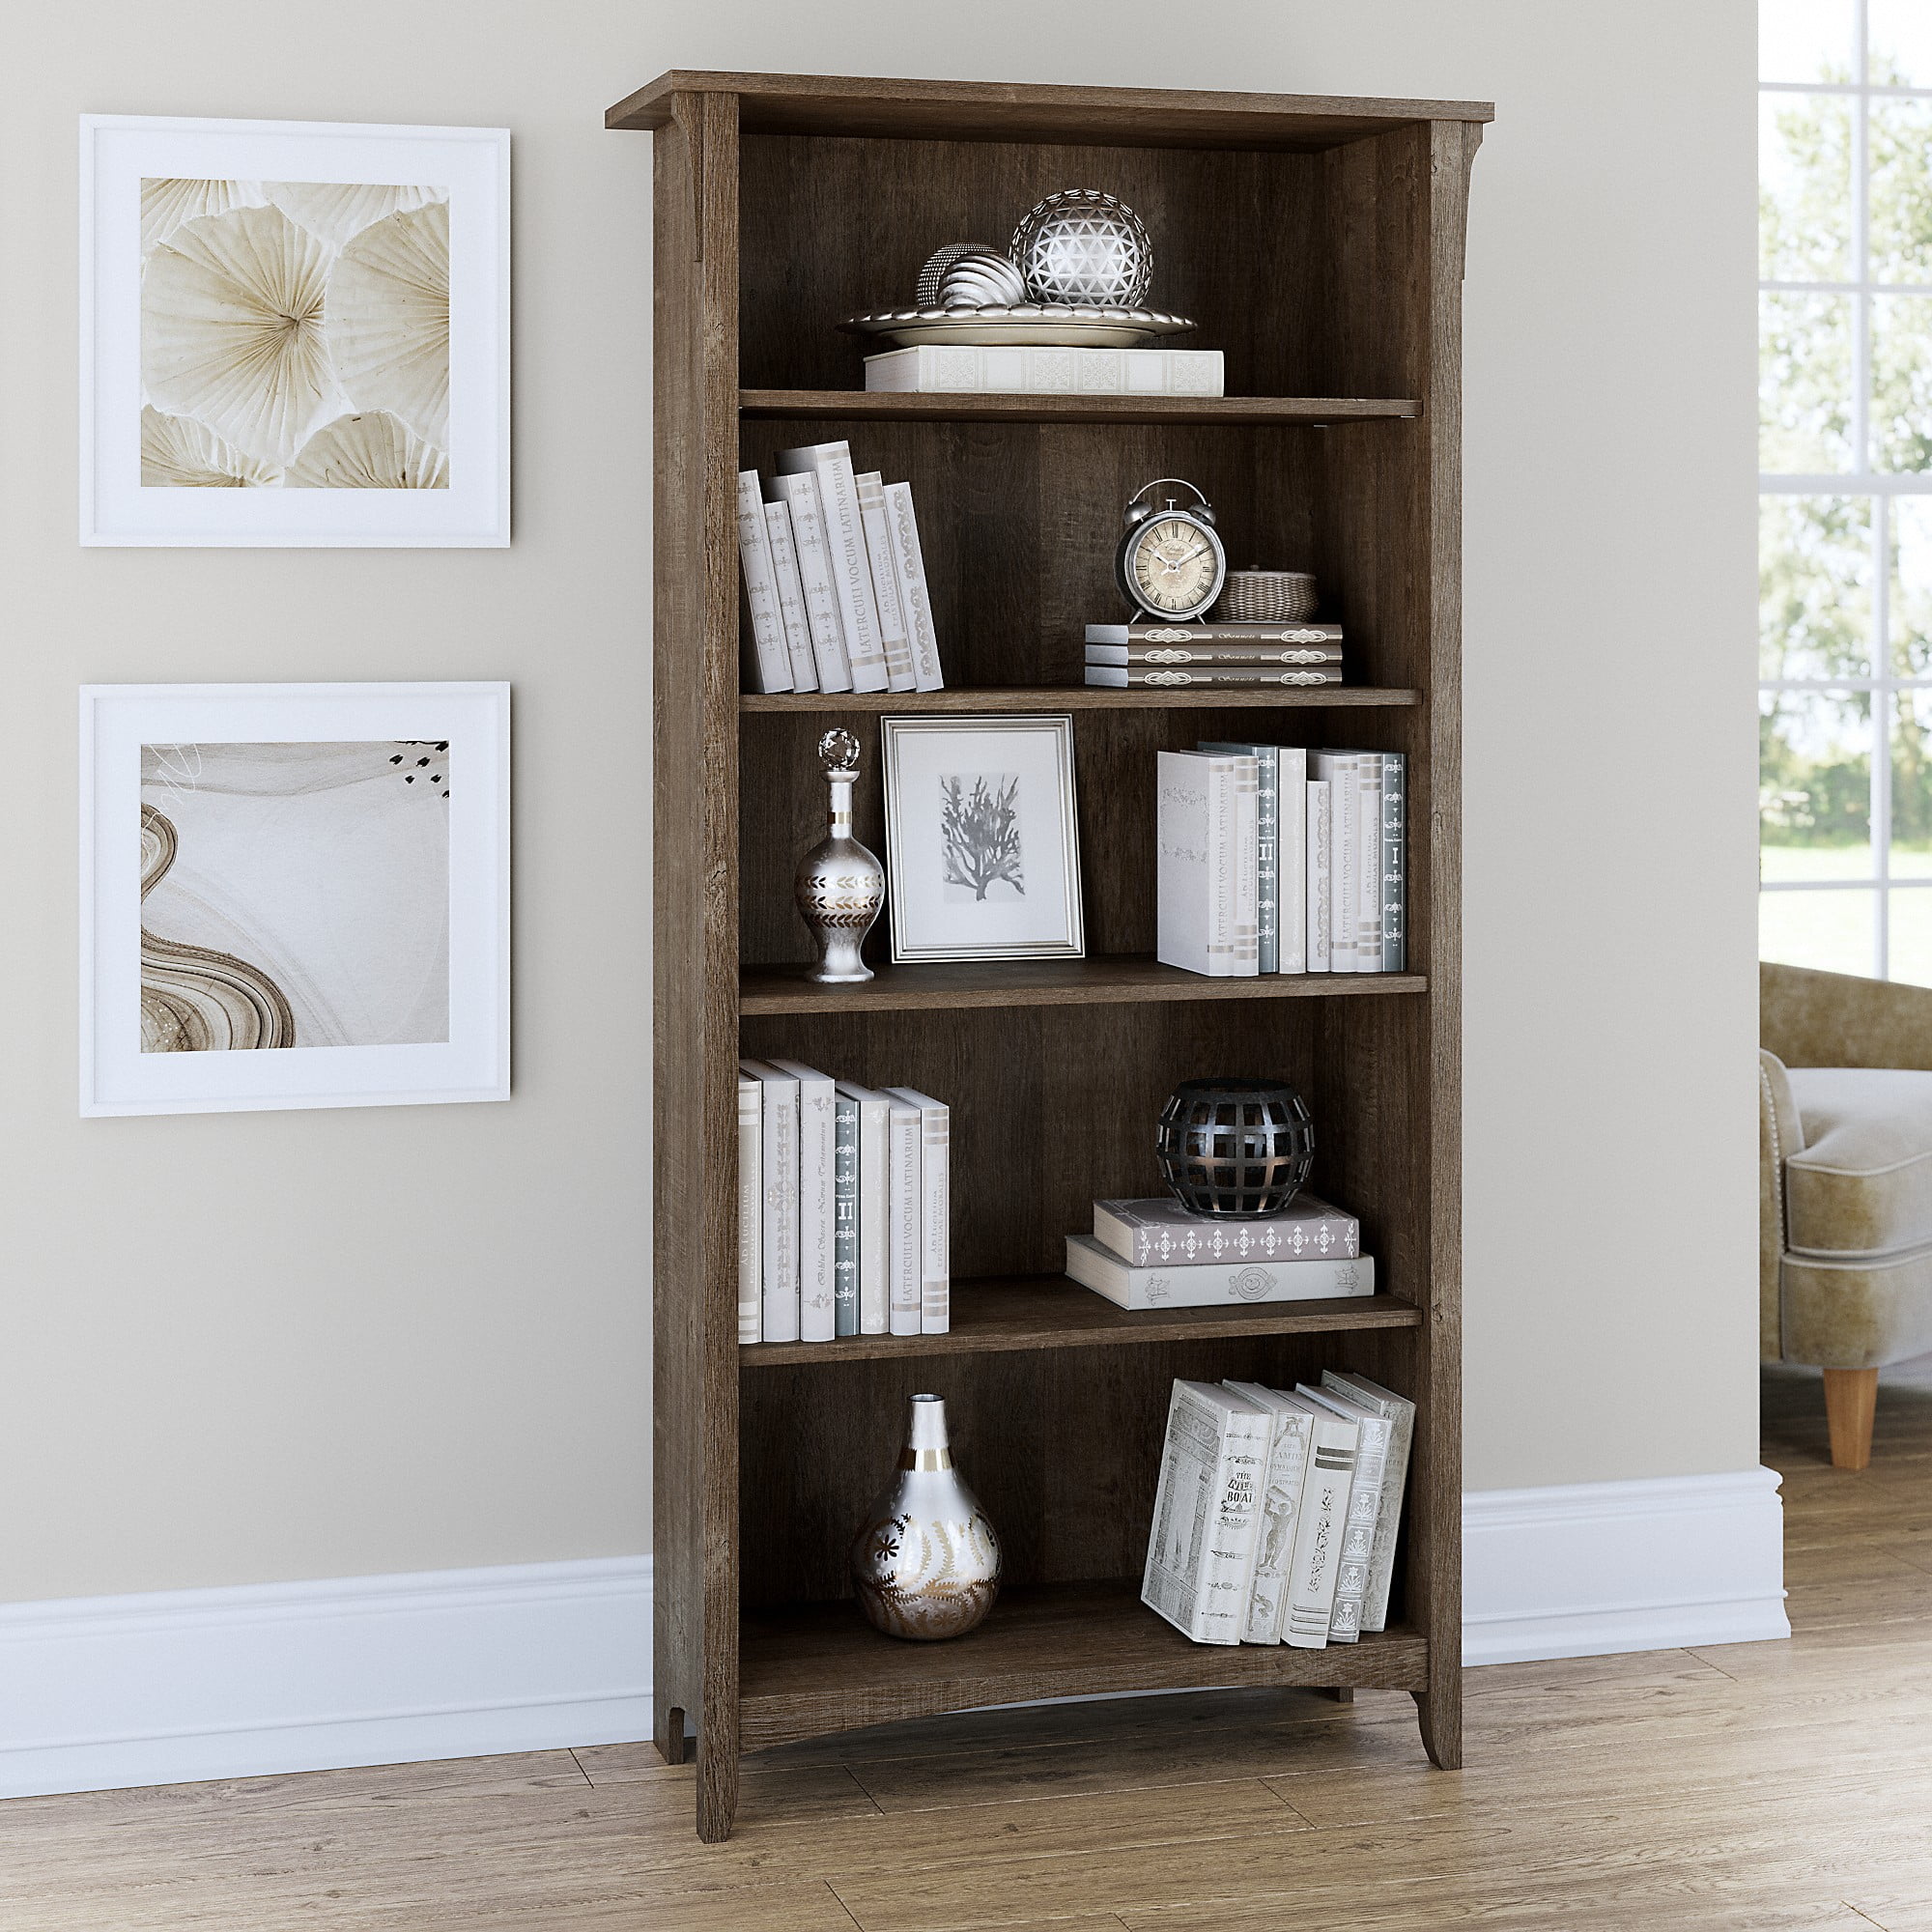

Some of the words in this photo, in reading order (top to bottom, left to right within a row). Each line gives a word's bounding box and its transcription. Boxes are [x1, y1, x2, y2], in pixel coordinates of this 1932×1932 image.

[834, 461, 853, 534] LATINARUM
[843, 537, 861, 584] VOCUM
[852, 586, 872, 654] LATERCULI
[1219, 774, 1230, 838] LATINARUM
[1343, 773, 1352, 836] LATINARUM
[1218, 841, 1229, 883] VOCUM
[1343, 838, 1352, 879] VOCUM
[903, 1127, 913, 1193] LATINARUM
[903, 1197, 913, 1238] VOCUM
[902, 1241, 913, 1301] LATERCULI
[1227, 1492, 1253, 1503] BOAT
[1236, 1471, 1252, 1481] THE
